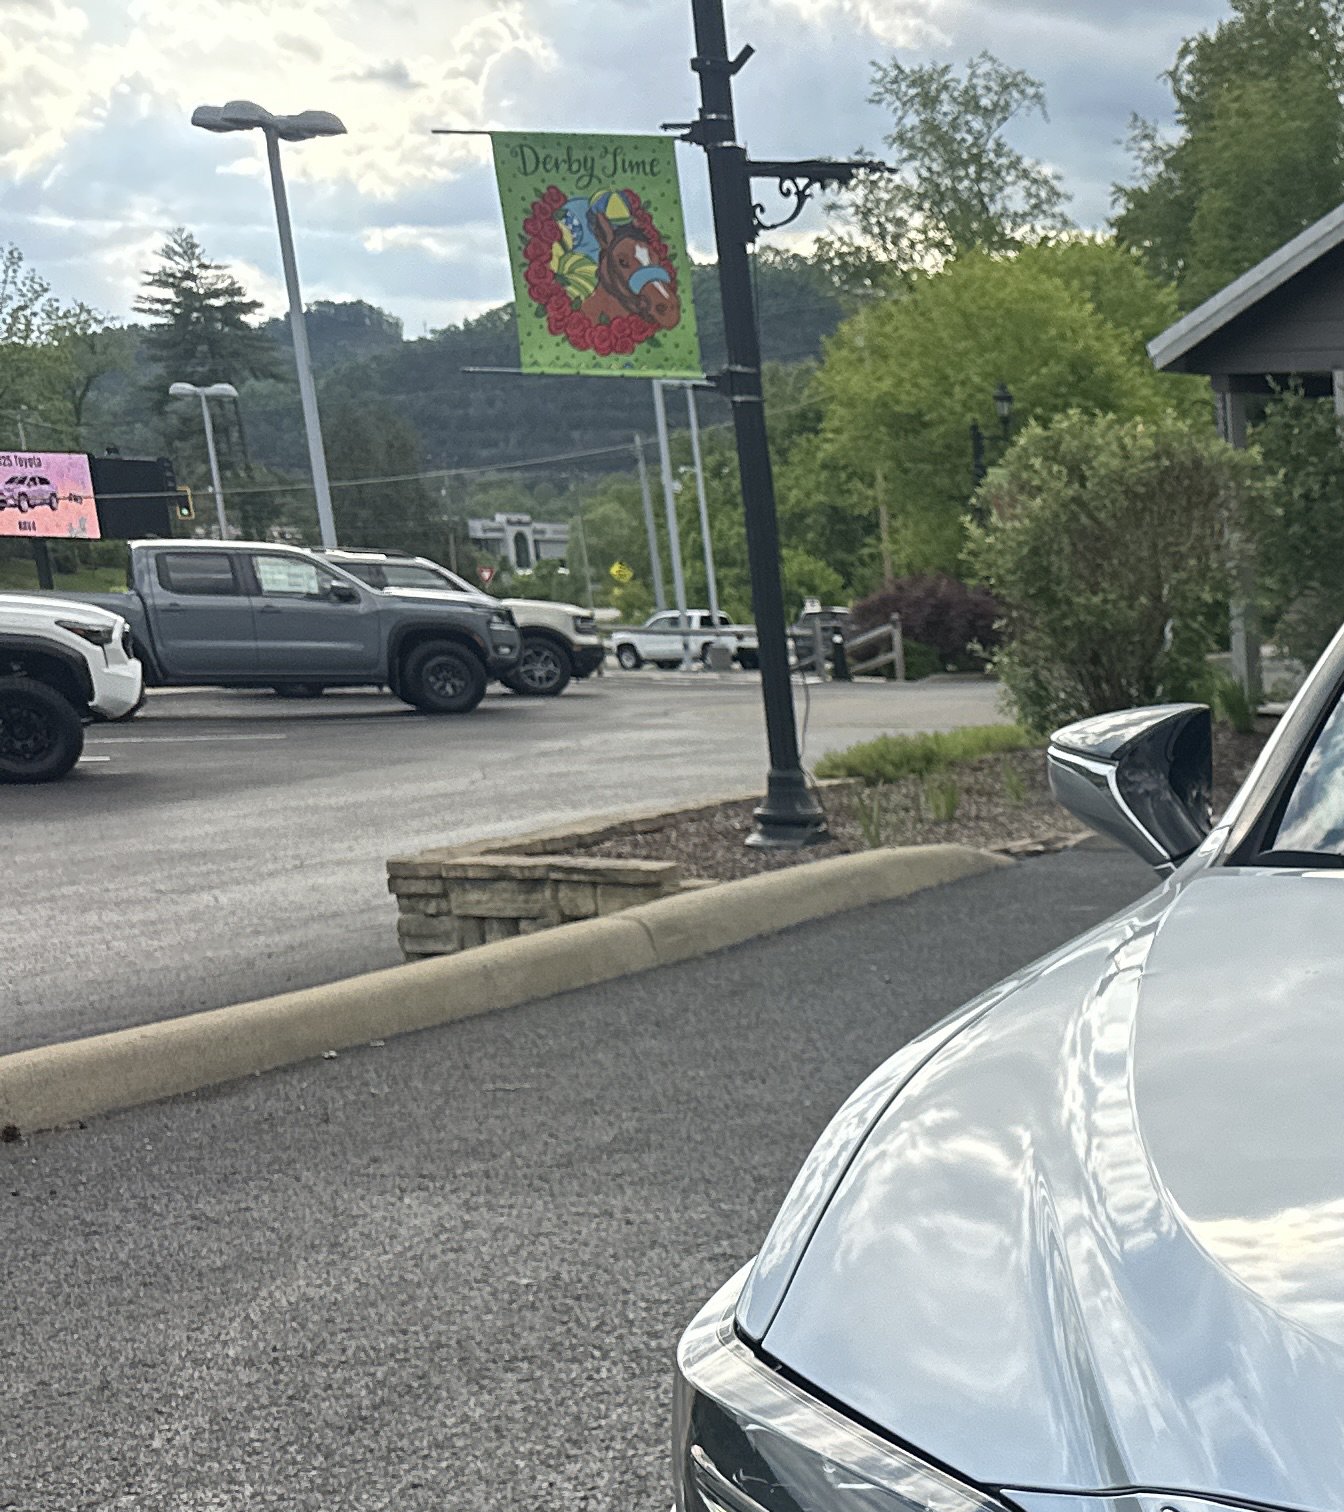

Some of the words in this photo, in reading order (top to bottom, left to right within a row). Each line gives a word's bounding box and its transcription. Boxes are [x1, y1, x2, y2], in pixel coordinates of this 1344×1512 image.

[510, 143, 602, 190] Derby
[600, 145, 661, 178] Time
[14, 454, 42, 469] Toyota
